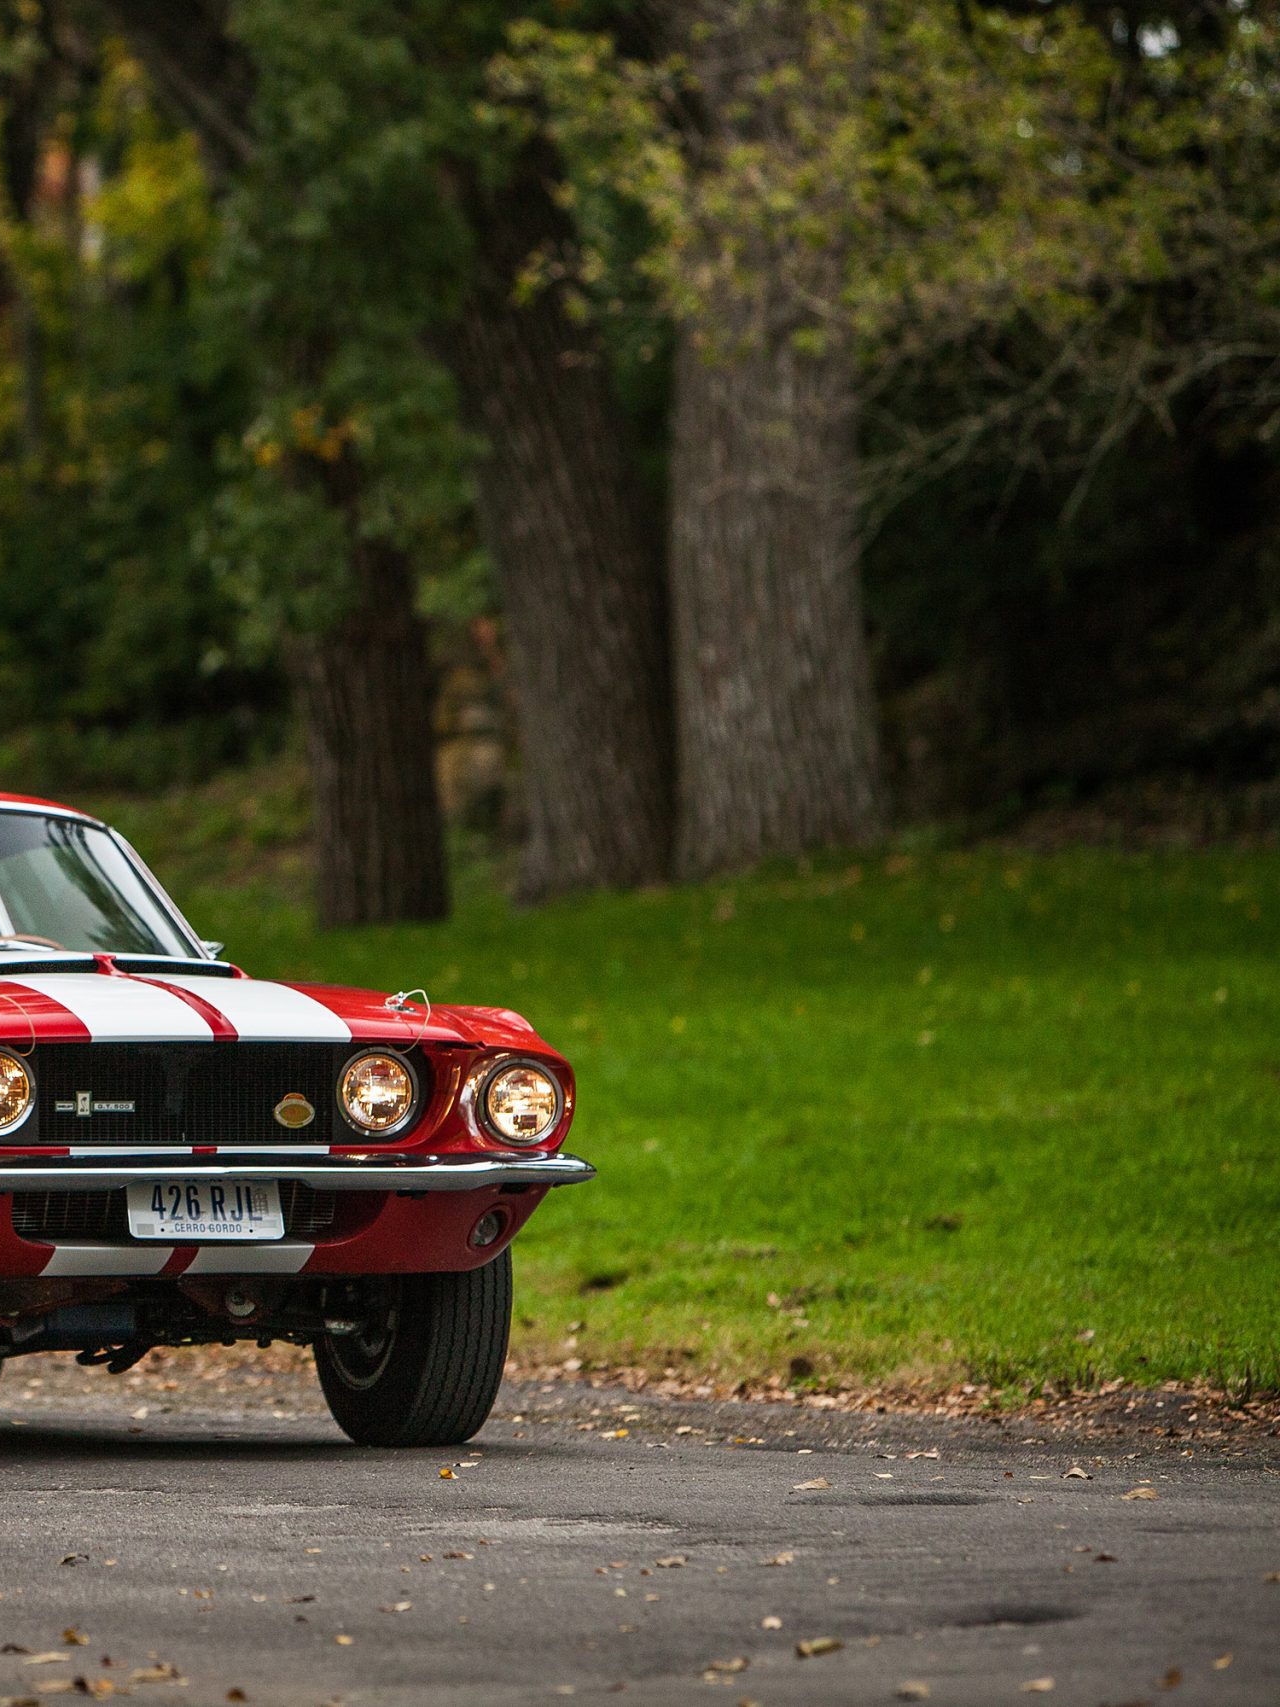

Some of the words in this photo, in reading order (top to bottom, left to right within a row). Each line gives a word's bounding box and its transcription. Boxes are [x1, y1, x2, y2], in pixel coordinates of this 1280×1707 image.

[151, 1185, 201, 1221] 426
[209, 1185, 263, 1222] RJL
[174, 1222, 206, 1233] CERRO
[208, 1223, 243, 1233] GORDO
